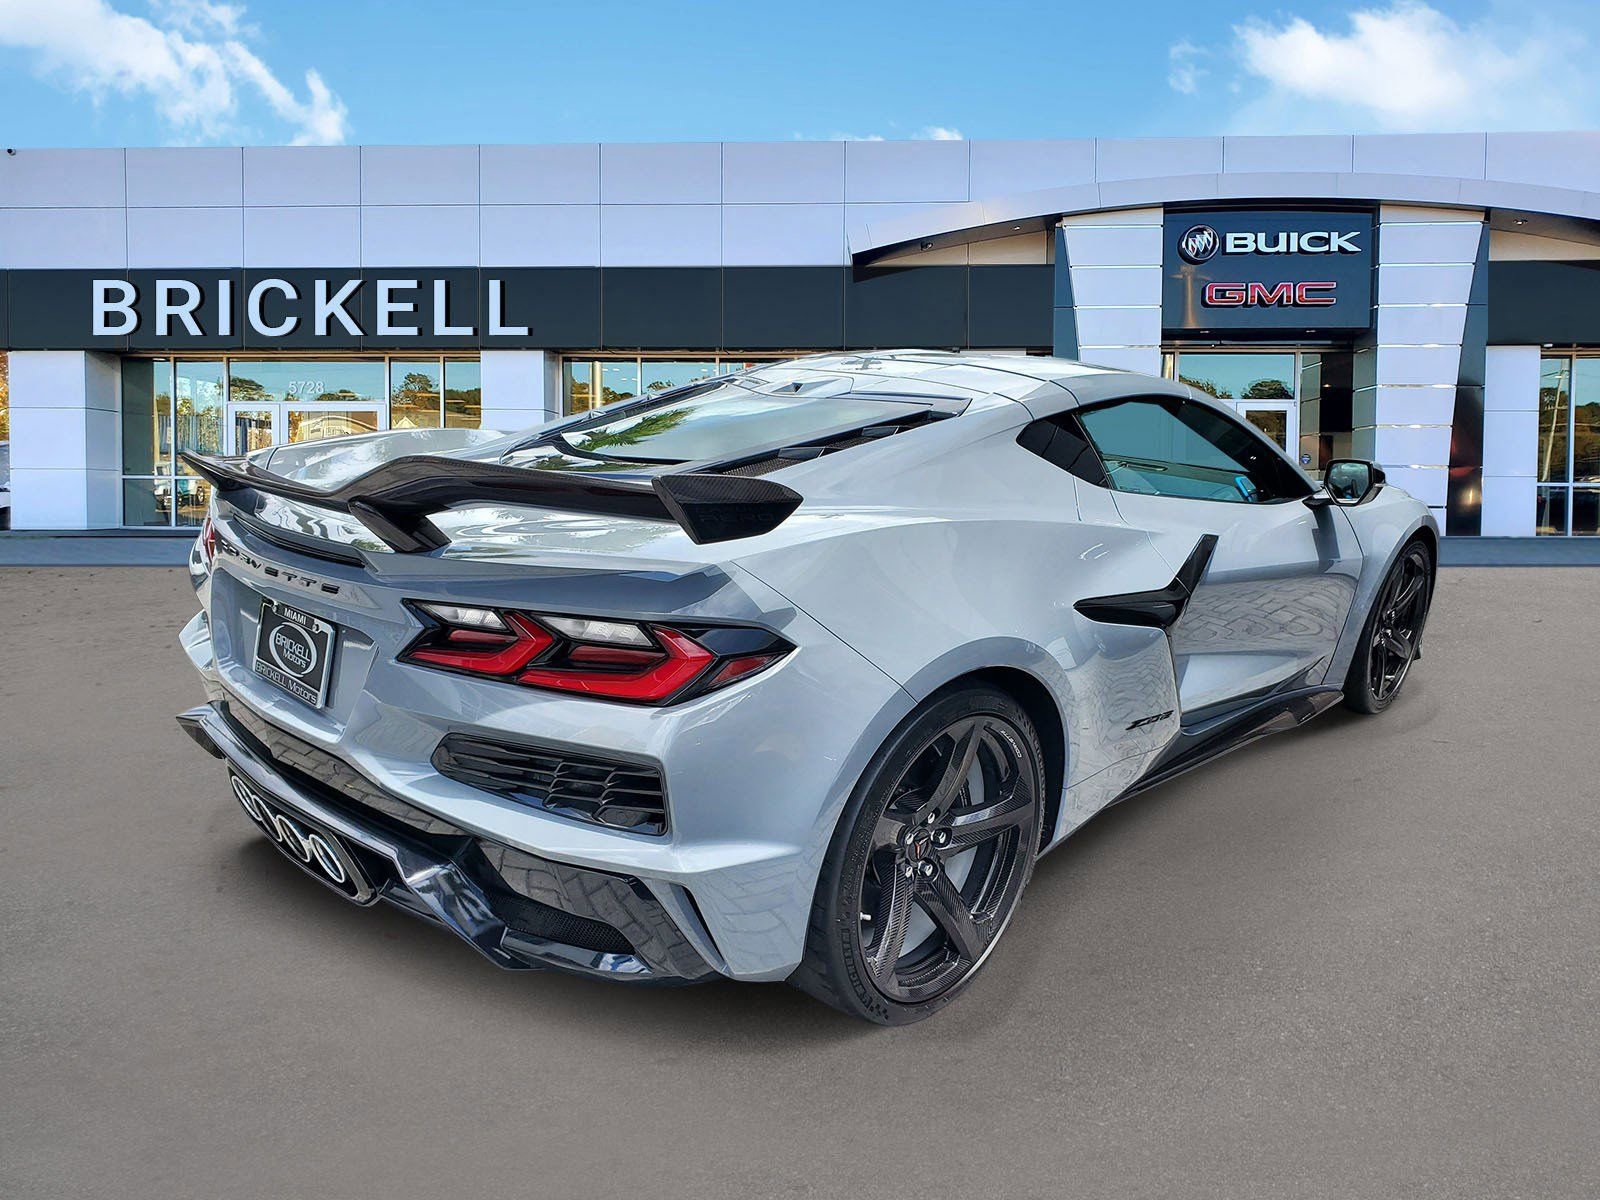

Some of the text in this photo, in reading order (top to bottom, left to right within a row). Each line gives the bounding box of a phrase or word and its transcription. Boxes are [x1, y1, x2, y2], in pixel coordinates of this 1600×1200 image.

[1226, 231, 1362, 253] BUICK
[1205, 281, 1337, 305] GMC
[91, 278, 531, 337] BRICKELL
[288, 380, 325, 395] 5728
[283, 607, 307, 626] MIAMI
[275, 632, 311, 662] BRICKELL
[255, 661, 287, 687] BRICKELL
